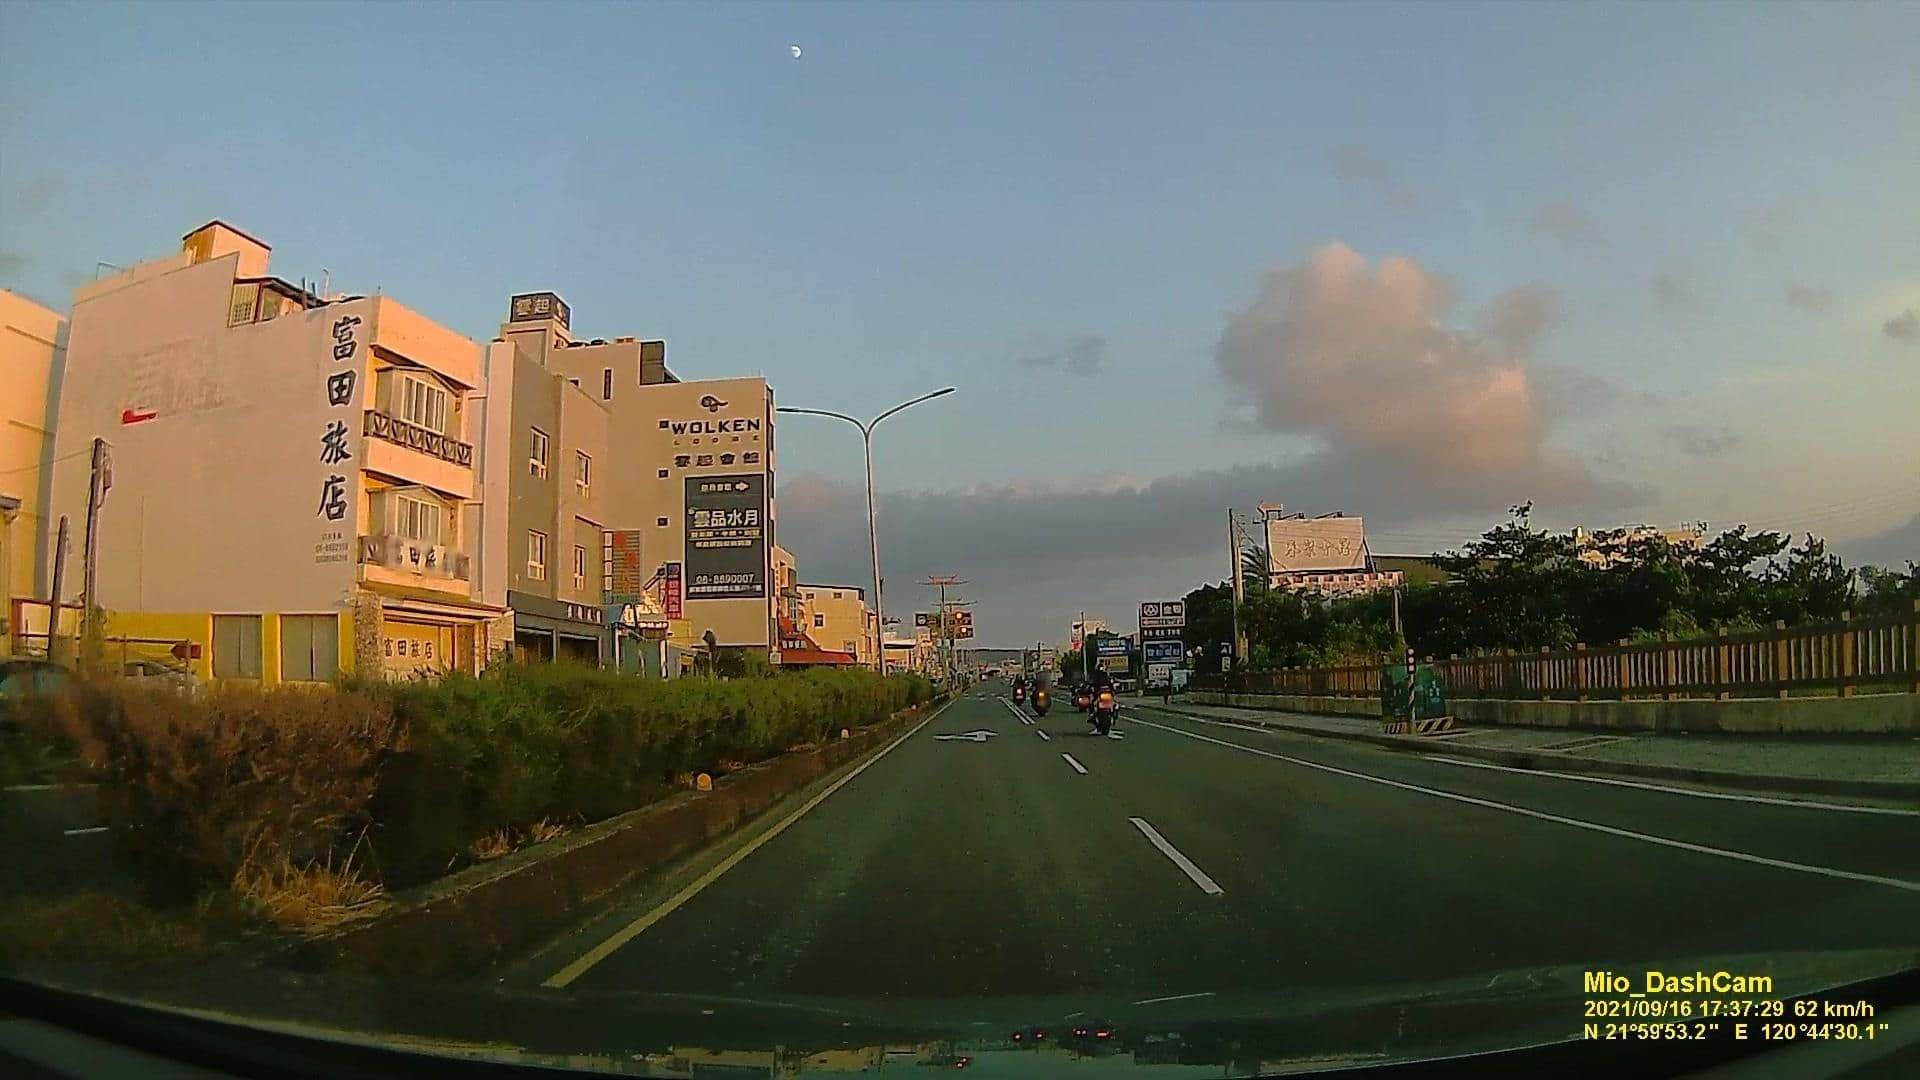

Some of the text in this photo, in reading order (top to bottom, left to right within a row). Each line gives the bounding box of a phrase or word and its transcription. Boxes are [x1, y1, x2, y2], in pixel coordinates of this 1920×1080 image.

[316, 315, 362, 521] 富田旅店
[672, 419, 760, 435] WOLKEN
